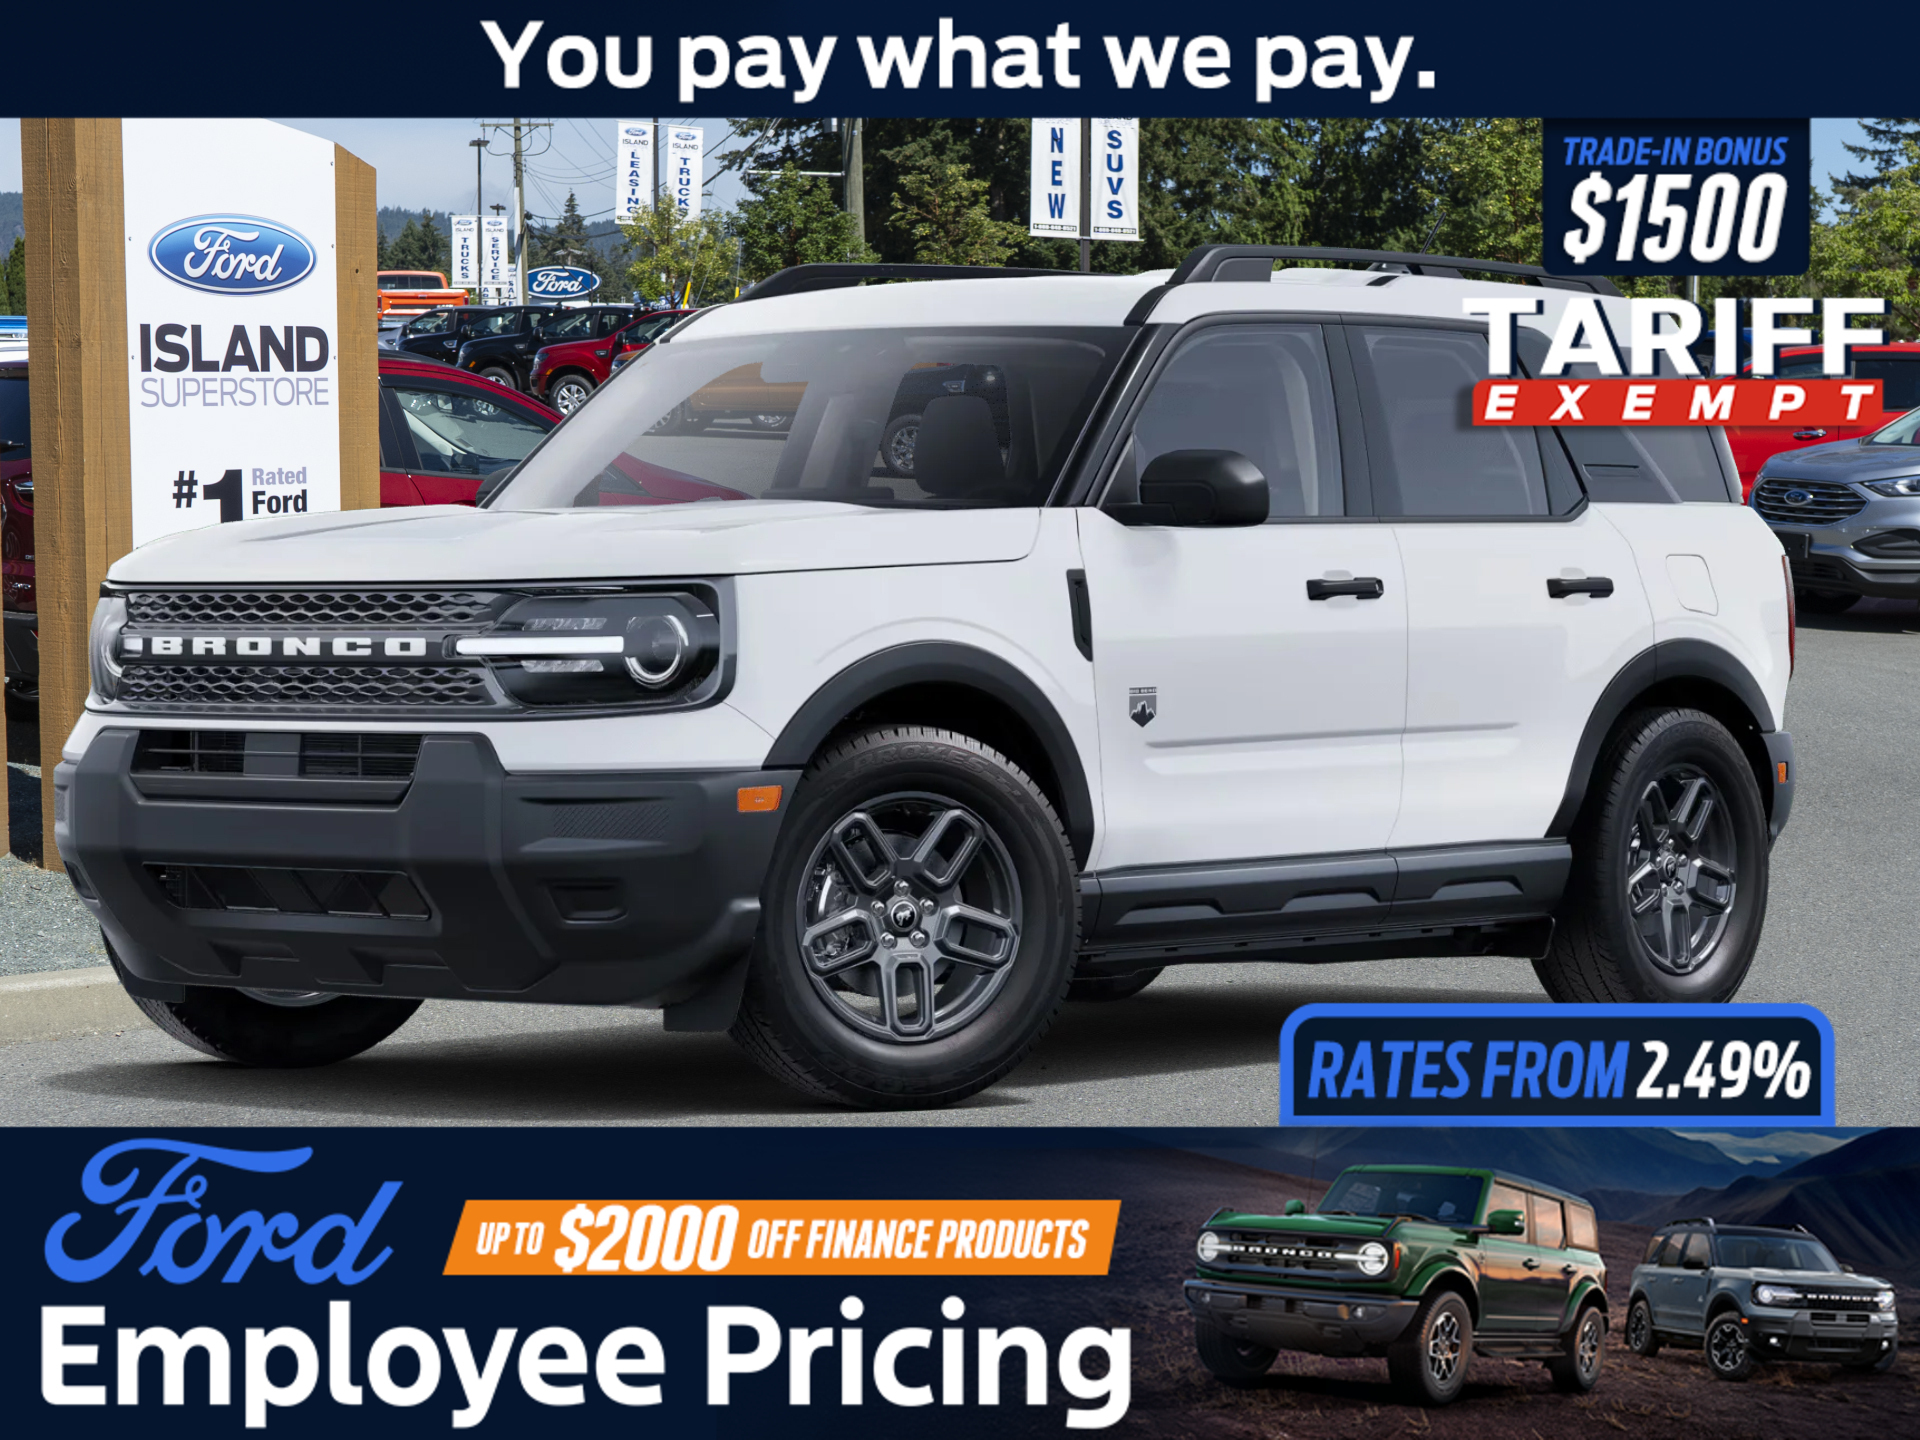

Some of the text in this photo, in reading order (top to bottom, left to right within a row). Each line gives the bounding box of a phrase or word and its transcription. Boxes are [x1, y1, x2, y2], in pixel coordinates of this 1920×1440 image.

[622, 138, 649, 146] ISLAND
[1048, 127, 1066, 219] NEW
[1106, 130, 1124, 219] SUVS
[183, 226, 285, 281] Ford
[460, 237, 470, 279] TRUCKS
[490, 236, 500, 280] SERVICE
[532, 270, 584, 293] Ford
[139, 323, 330, 373] ISLAND
[140, 376, 330, 408] SUPERSTORE
[251, 466, 307, 486] Rated
[251, 489, 308, 515] Ford
[151, 636, 427, 657] BRONCO
